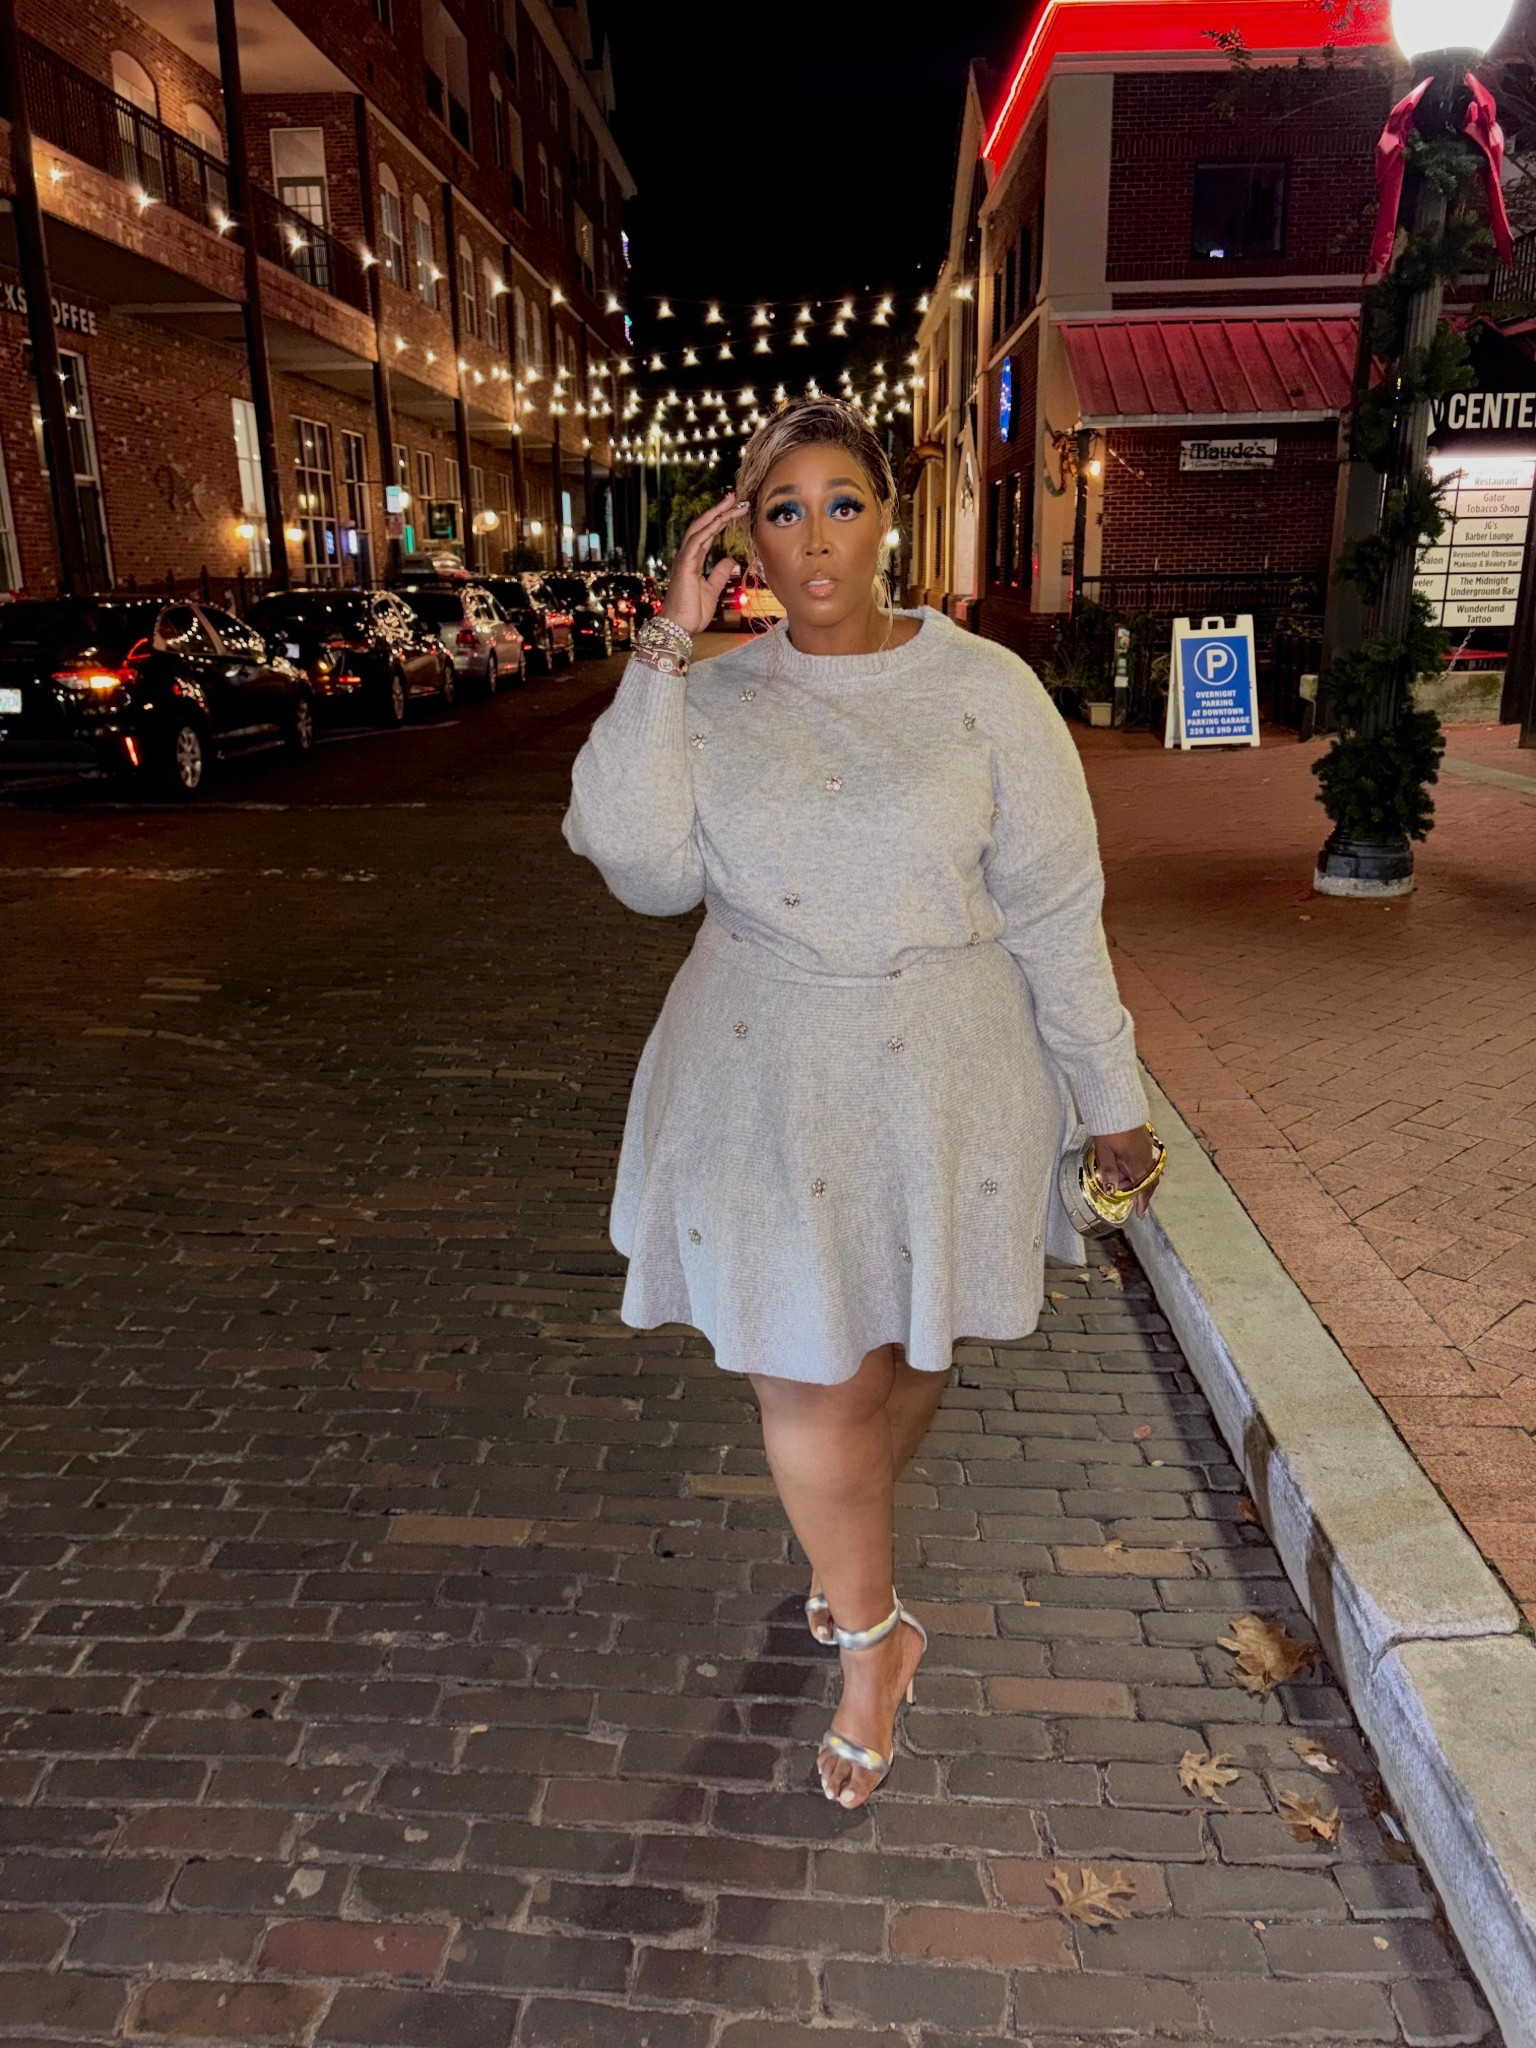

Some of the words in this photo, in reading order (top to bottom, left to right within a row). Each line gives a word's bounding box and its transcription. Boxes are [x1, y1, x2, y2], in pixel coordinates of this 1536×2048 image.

[50, 297, 98, 336] OFFEE
[1448, 392, 1536, 430] CENTE
[1475, 477, 1518, 486] Restaurant
[1483, 494, 1506, 502] Gator
[1467, 505, 1498, 513] Tobacco
[1500, 504, 1520, 513] Shop
[1484, 521, 1498, 530] JG's
[1465, 532, 1488, 541] Barber
[1489, 532, 1514, 541] Lounge
[1491, 550, 1522, 558] Obsession
[1485, 560, 1506, 568] Beauty
[1413, 578, 1434, 587] veler
[1460, 577, 1474, 585] The
[1475, 576, 1509, 586] Midnight
[1450, 587, 1500, 597] Underground
[1502, 586, 1515, 595] Bar
[1456, 604, 1505, 613] Wunderland
[1467, 614, 1492, 623] Tattoo
[1206, 649, 1228, 679] P
[1195, 690, 1237, 699] OVERNIGHT
[1201, 699, 1234, 707] PARKING
[1192, 709, 1201, 717] AT
[1202, 708, 1244, 717] DOWNTOWN
[1187, 717, 1219, 726] PARKING
[1221, 716, 1250, 725] GARAGE
[1189, 727, 1204, 735] 220
[1216, 726, 1232, 734] 2ND
[1233, 725, 1247, 733] AVE
